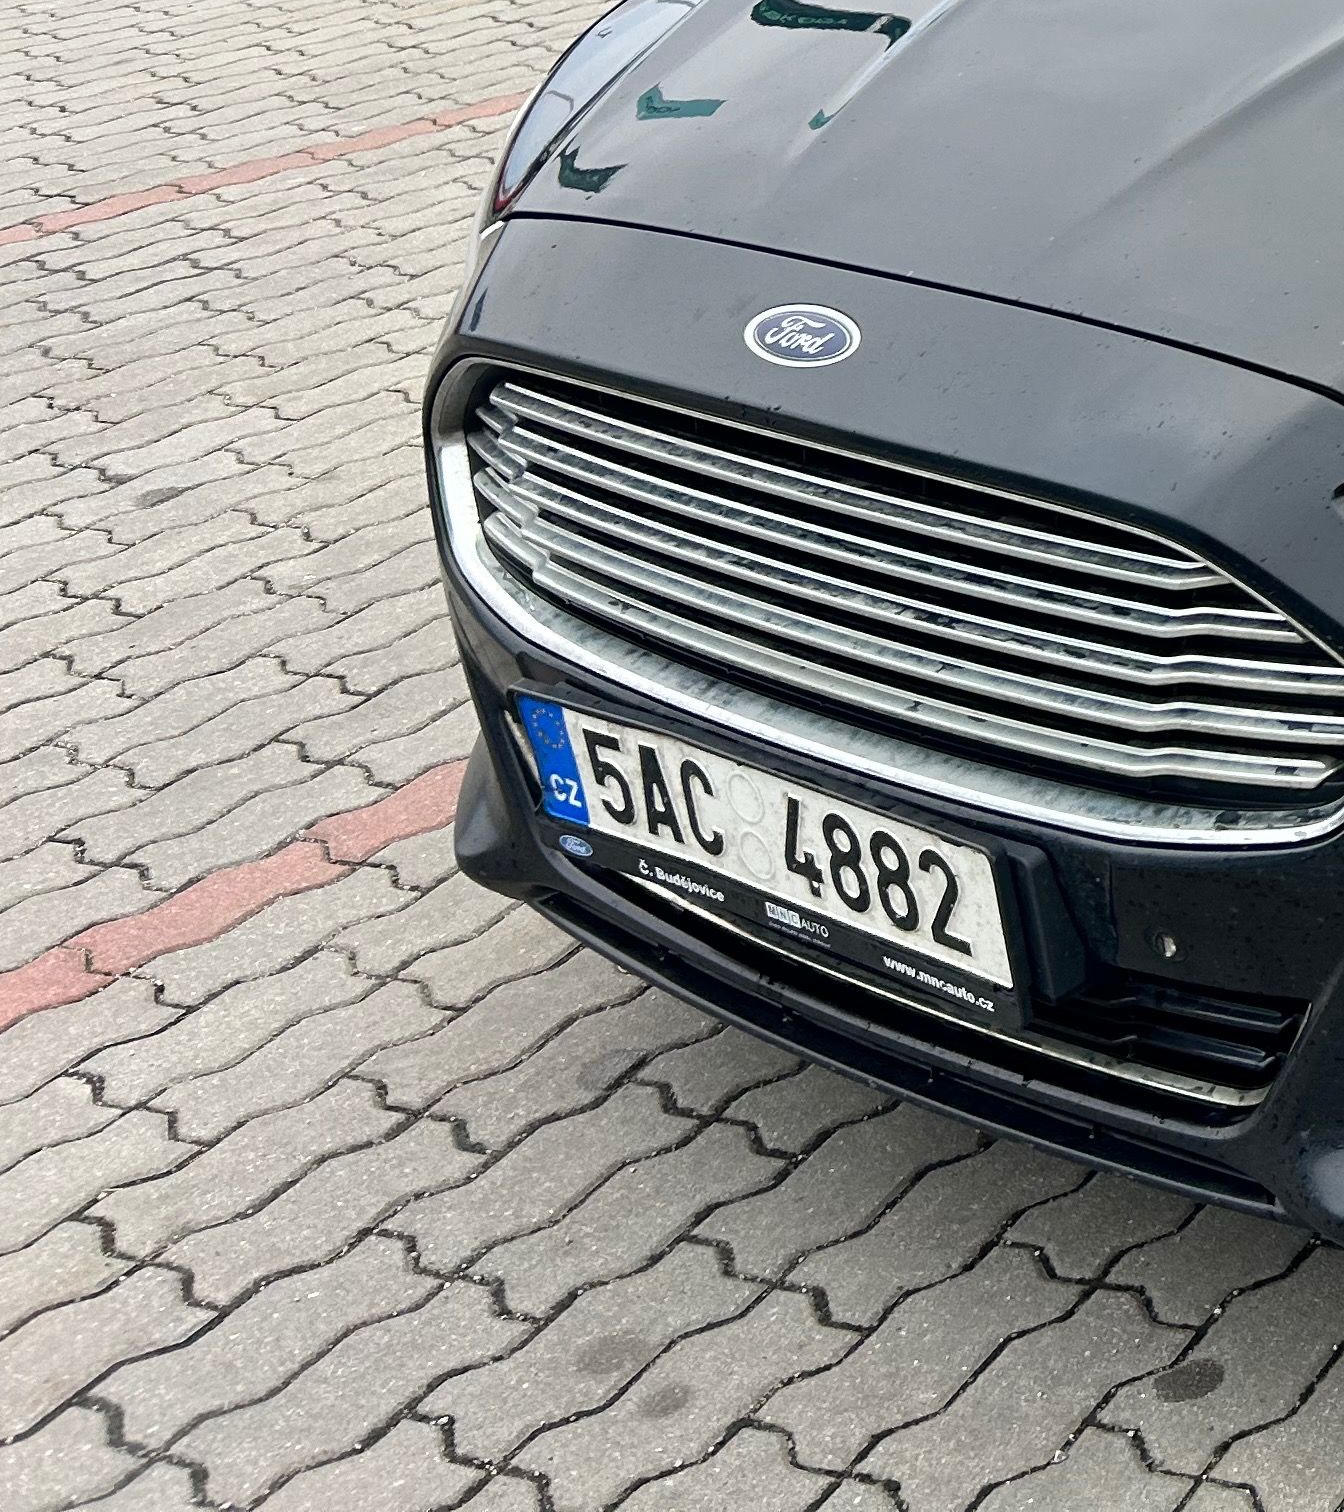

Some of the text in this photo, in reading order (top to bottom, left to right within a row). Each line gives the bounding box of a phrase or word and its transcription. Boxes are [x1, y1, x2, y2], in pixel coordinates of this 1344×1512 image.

[764, 315, 835, 355] Ford
[550, 773, 583, 808] CZ
[582, 727, 973, 958] 5AC 4882
[654, 866, 726, 903] Budějovice
[882, 955, 996, 1013] www.mncauto.cz
